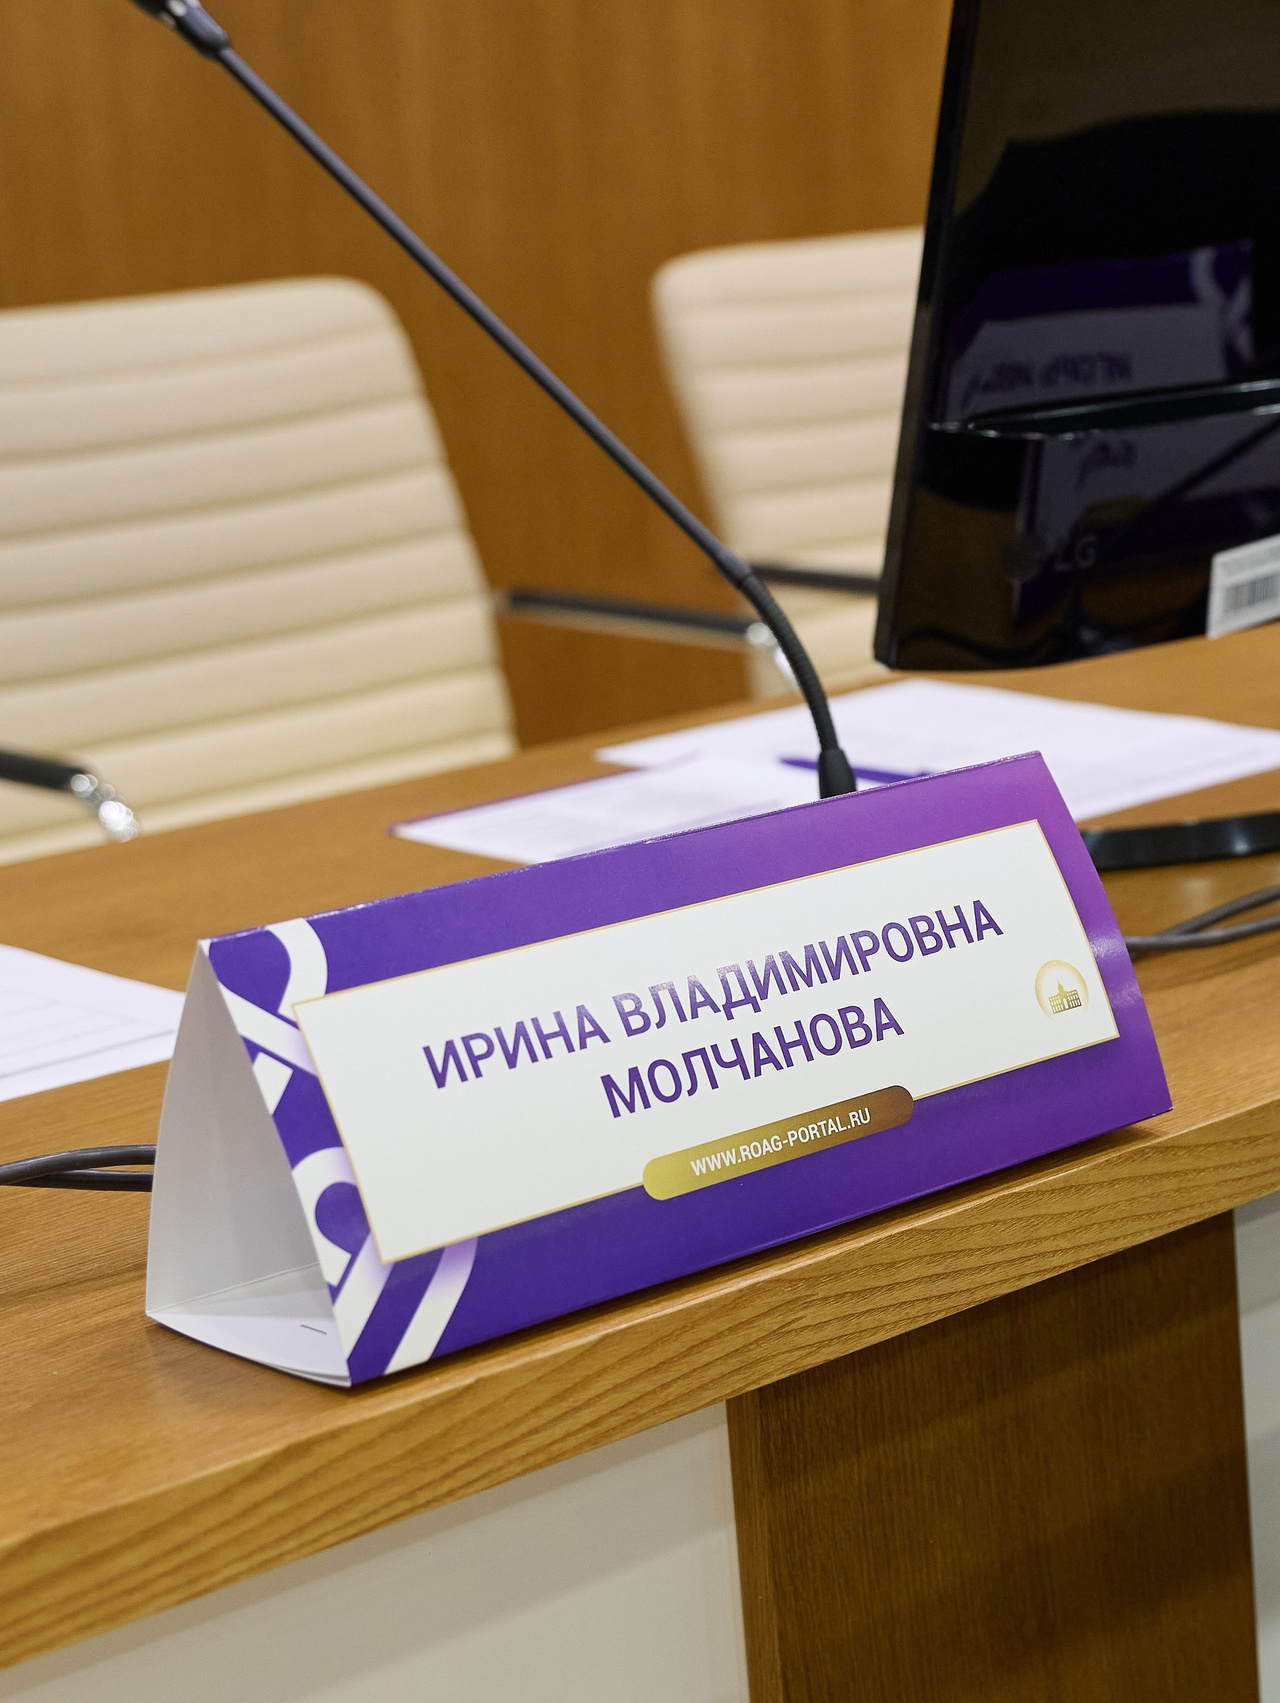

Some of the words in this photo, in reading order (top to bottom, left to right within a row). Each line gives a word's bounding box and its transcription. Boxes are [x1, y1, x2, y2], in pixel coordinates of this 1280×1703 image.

[422, 1004, 611, 1090] ИРИНА
[610, 899, 1005, 1038] ВЛАДИМИРОВНА
[599, 996, 905, 1119] МОЛЧАНОВА
[689, 1107, 872, 1178] WWW.ROAG-PORTAL.RU
